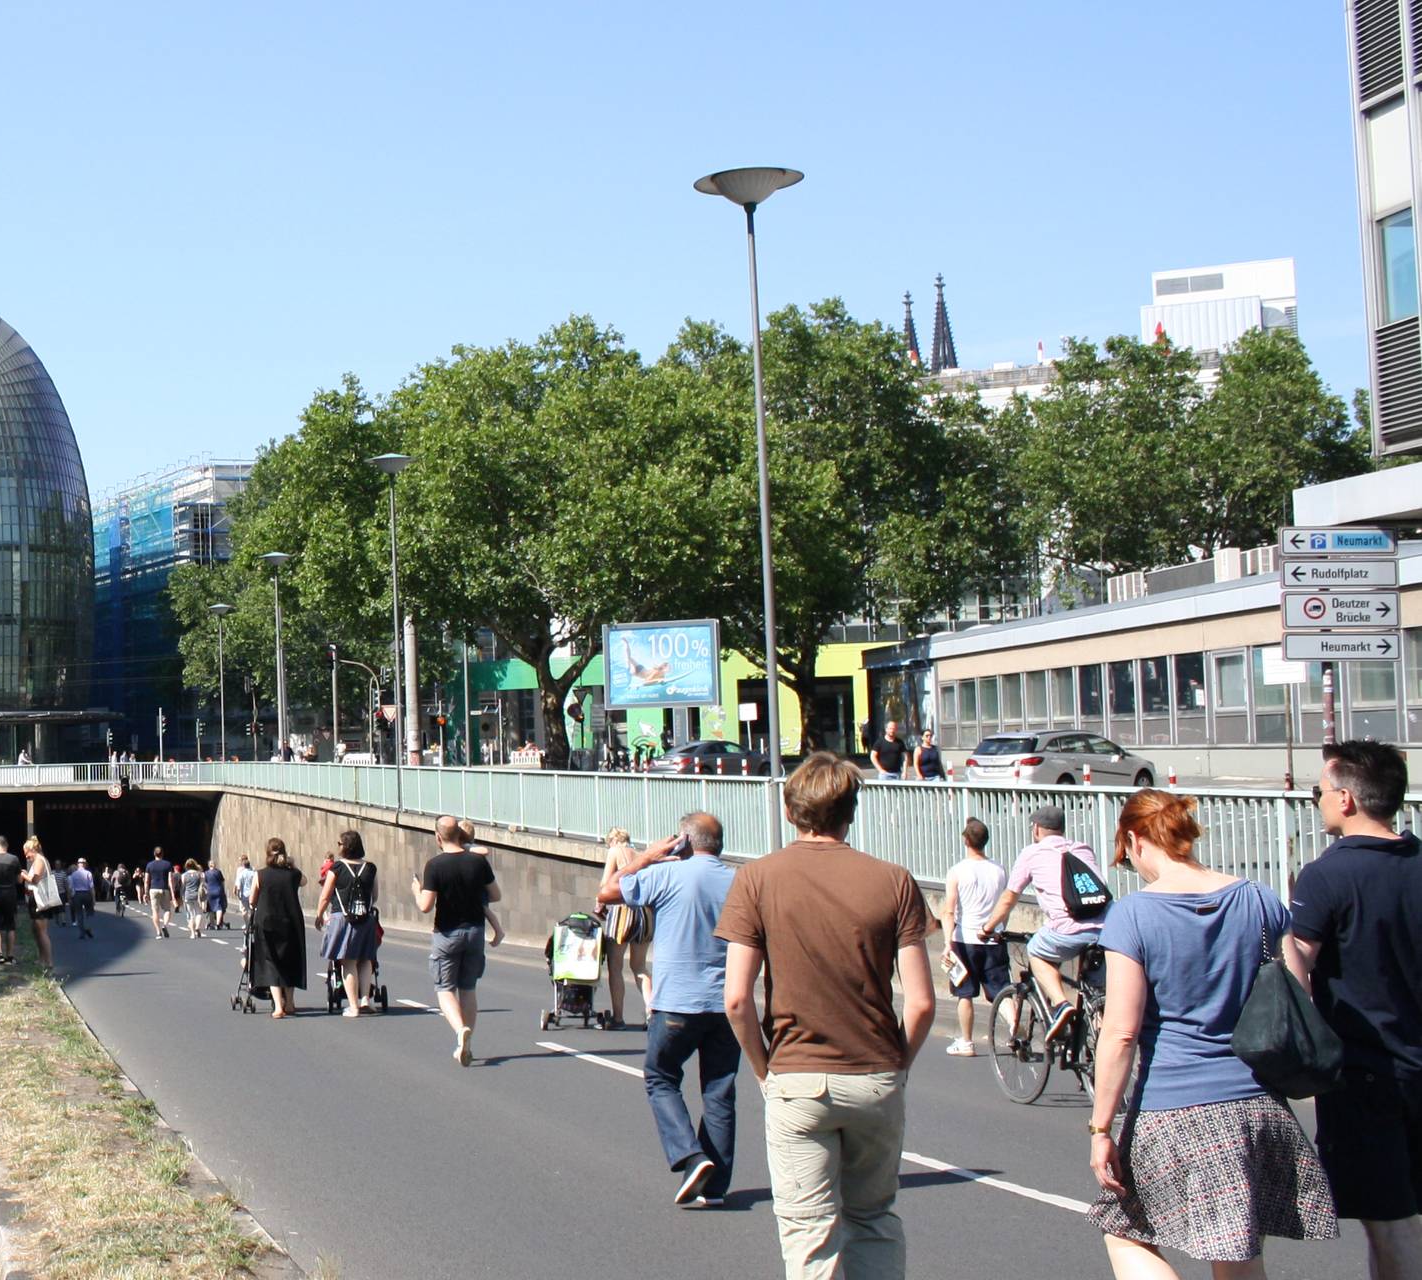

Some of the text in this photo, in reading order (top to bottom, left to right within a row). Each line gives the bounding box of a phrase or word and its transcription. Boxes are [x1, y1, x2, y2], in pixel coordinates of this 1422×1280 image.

[1337, 534, 1383, 546] Neumarkt
[1311, 568, 1369, 581] Rudolfplatz
[1332, 598, 1370, 609] Deutzer
[1336, 611, 1371, 623] Brücke
[1321, 641, 1371, 652] Heumarkt
